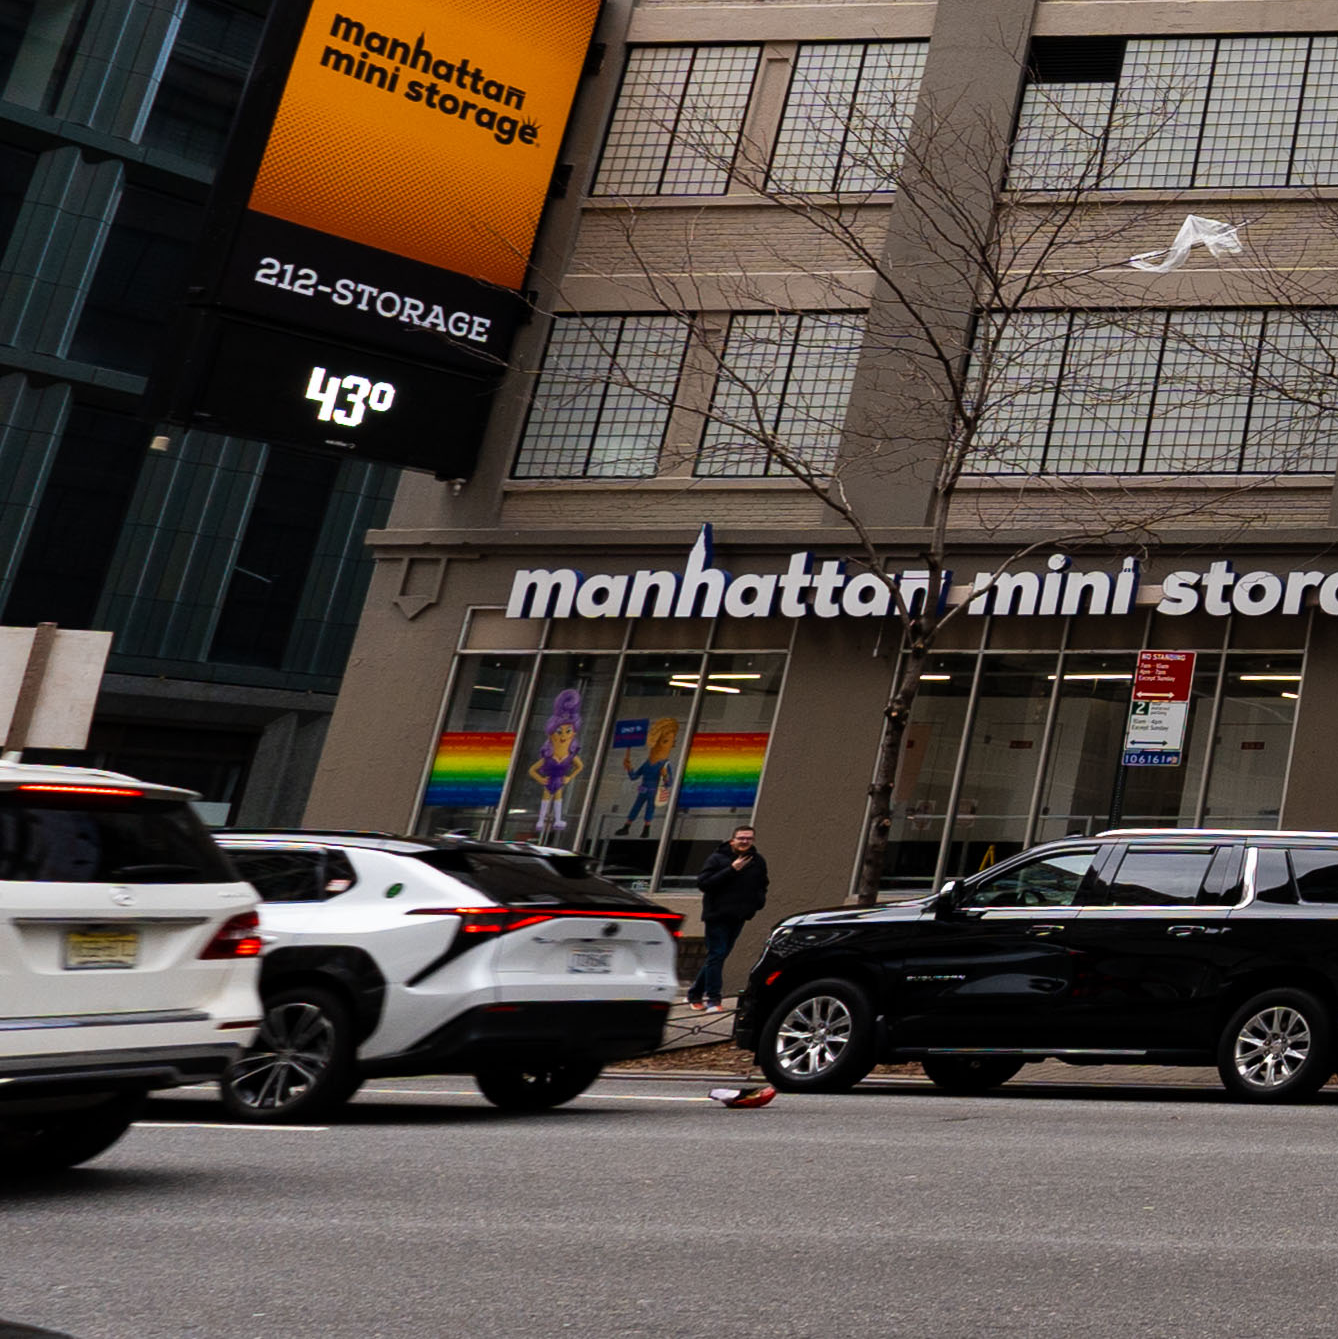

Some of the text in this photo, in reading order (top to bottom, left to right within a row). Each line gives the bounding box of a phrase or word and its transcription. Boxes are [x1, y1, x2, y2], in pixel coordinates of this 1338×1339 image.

[320, 43, 542, 146] mini storage
[329, 12, 526, 111] manhattan
[254, 257, 491, 342] 212-STORAGE
[506, 523, 952, 619] manhattan
[968, 553, 1137, 617] mini
[1136, 702, 1146, 714] 2
